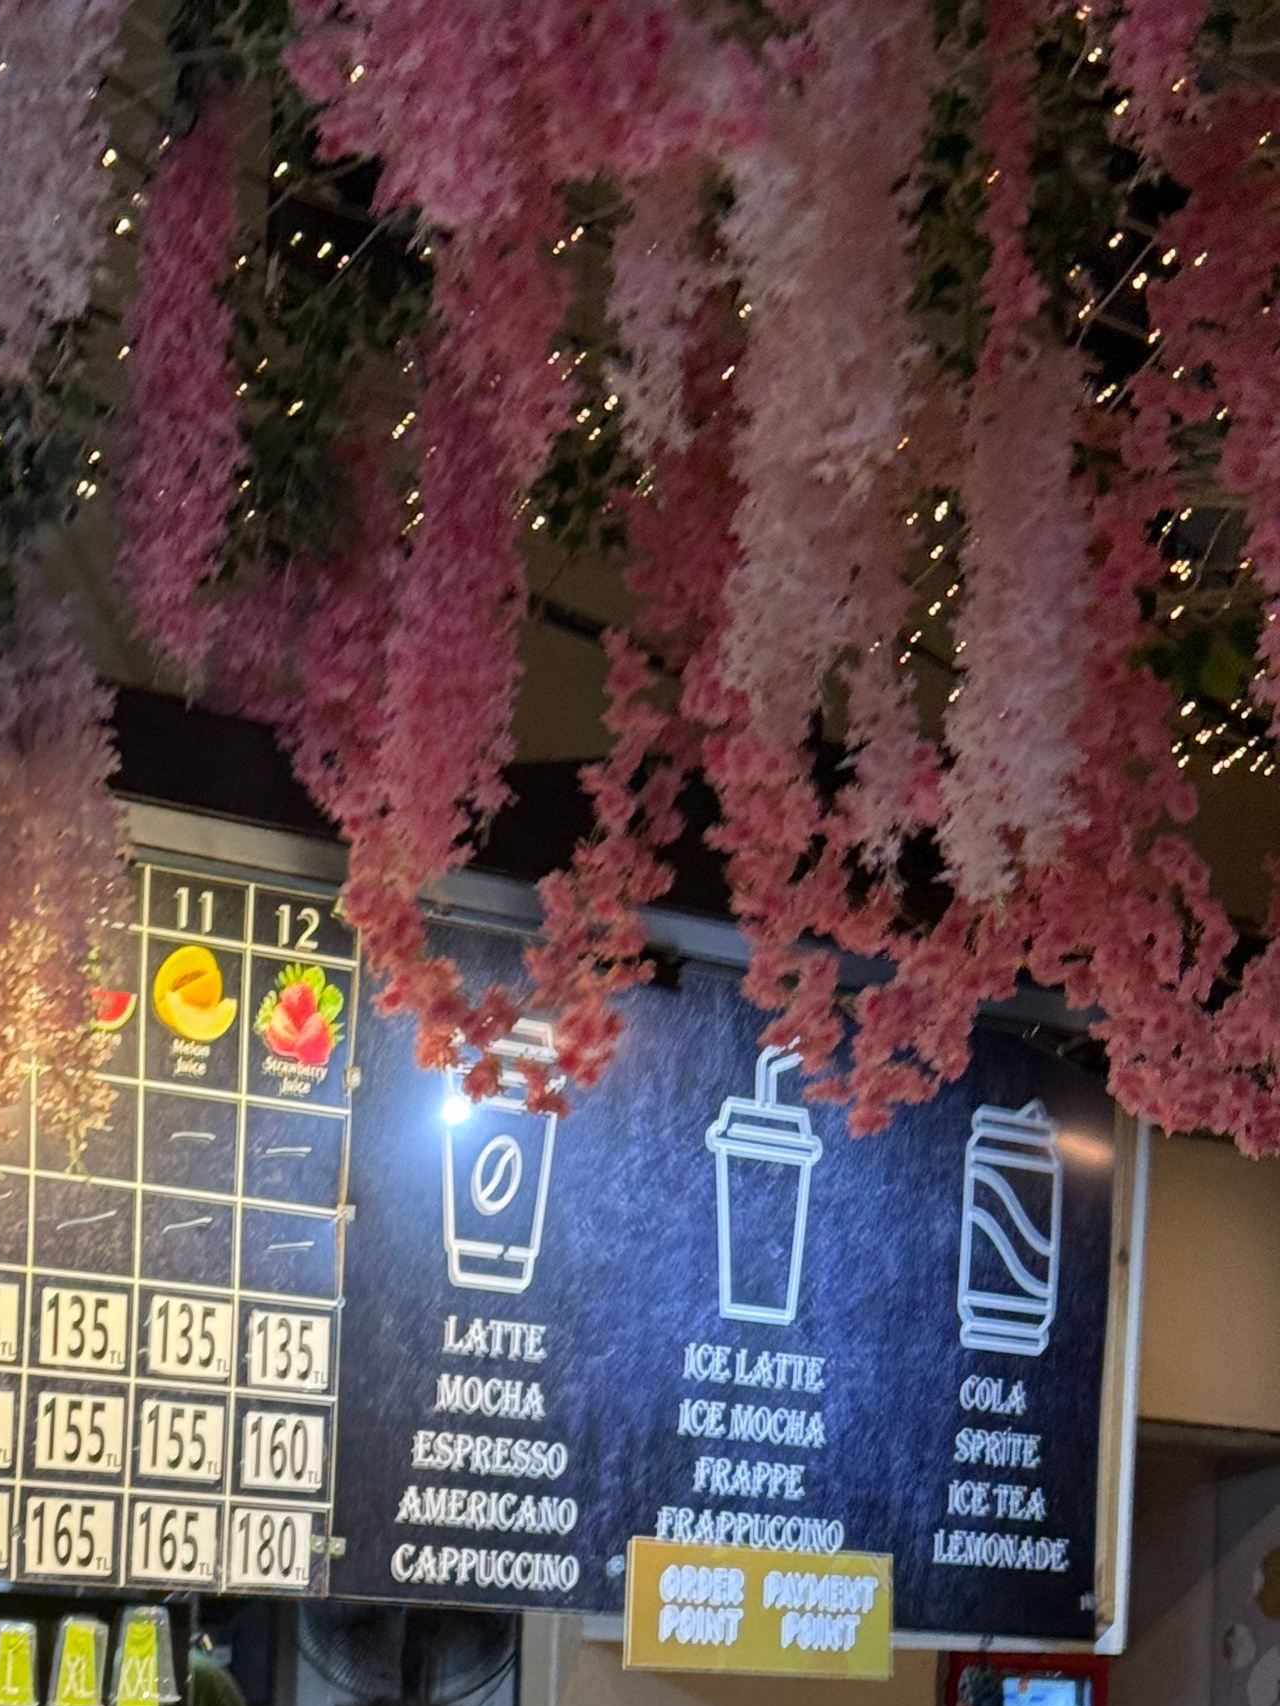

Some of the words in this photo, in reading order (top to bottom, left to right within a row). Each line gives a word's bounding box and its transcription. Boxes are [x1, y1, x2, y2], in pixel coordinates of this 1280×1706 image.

[175, 886, 215, 934] 11
[275, 903, 320, 952] 12
[170, 1038, 211, 1059] Melon
[173, 1057, 208, 1078] Juice
[261, 1055, 328, 1083] Strawberry
[279, 1076, 312, 1097] Juice
[0, 1341, 16, 1356] TL
[48, 1292, 108, 1360] 135
[110, 1350, 124, 1365] TL
[157, 1301, 215, 1367] 135
[216, 1358, 230, 1372] TL
[257, 1316, 313, 1380] 135
[313, 1371, 328, 1384] TL
[442, 1315, 547, 1363] LATTE
[682, 1342, 732, 1384] ICE
[734, 1348, 826, 1394] LATTE
[434, 1373, 546, 1421] MOCHA
[959, 1375, 1027, 1416] COLA
[44, 1397, 105, 1463] 155
[105, 1454, 120, 1467] TL
[148, 1405, 206, 1470] 155
[207, 1461, 221, 1474] TL
[677, 1398, 727, 1438] ICE
[727, 1404, 826, 1449] MOCHA
[250, 1416, 308, 1480] 160
[308, 1471, 321, 1484] TL
[411, 1430, 568, 1480] ESPRESSO
[692, 1456, 805, 1500] FRAPPE
[947, 1480, 990, 1517] ICE
[992, 1483, 1047, 1522] TEA
[395, 1485, 578, 1536] AMERICANO
[655, 1506, 845, 1555] FRAPPUCCINO
[32, 1502, 94, 1566] 165
[96, 1557, 111, 1570] TL
[139, 1506, 198, 1571] 165
[199, 1562, 213, 1576] TL
[239, 1513, 297, 1576] 180
[295, 1567, 309, 1580] TL
[933, 1529, 1070, 1573] LEMONADE
[391, 1543, 579, 1592] CAPPUCCINO
[659, 1564, 744, 1606] ORDER
[763, 1571, 878, 1614] PAYMENT
[658, 1605, 744, 1646] POINT
[781, 1612, 860, 1651] POINT
[5, 1646, 20, 1695] L
[61, 1655, 95, 1699] XL
